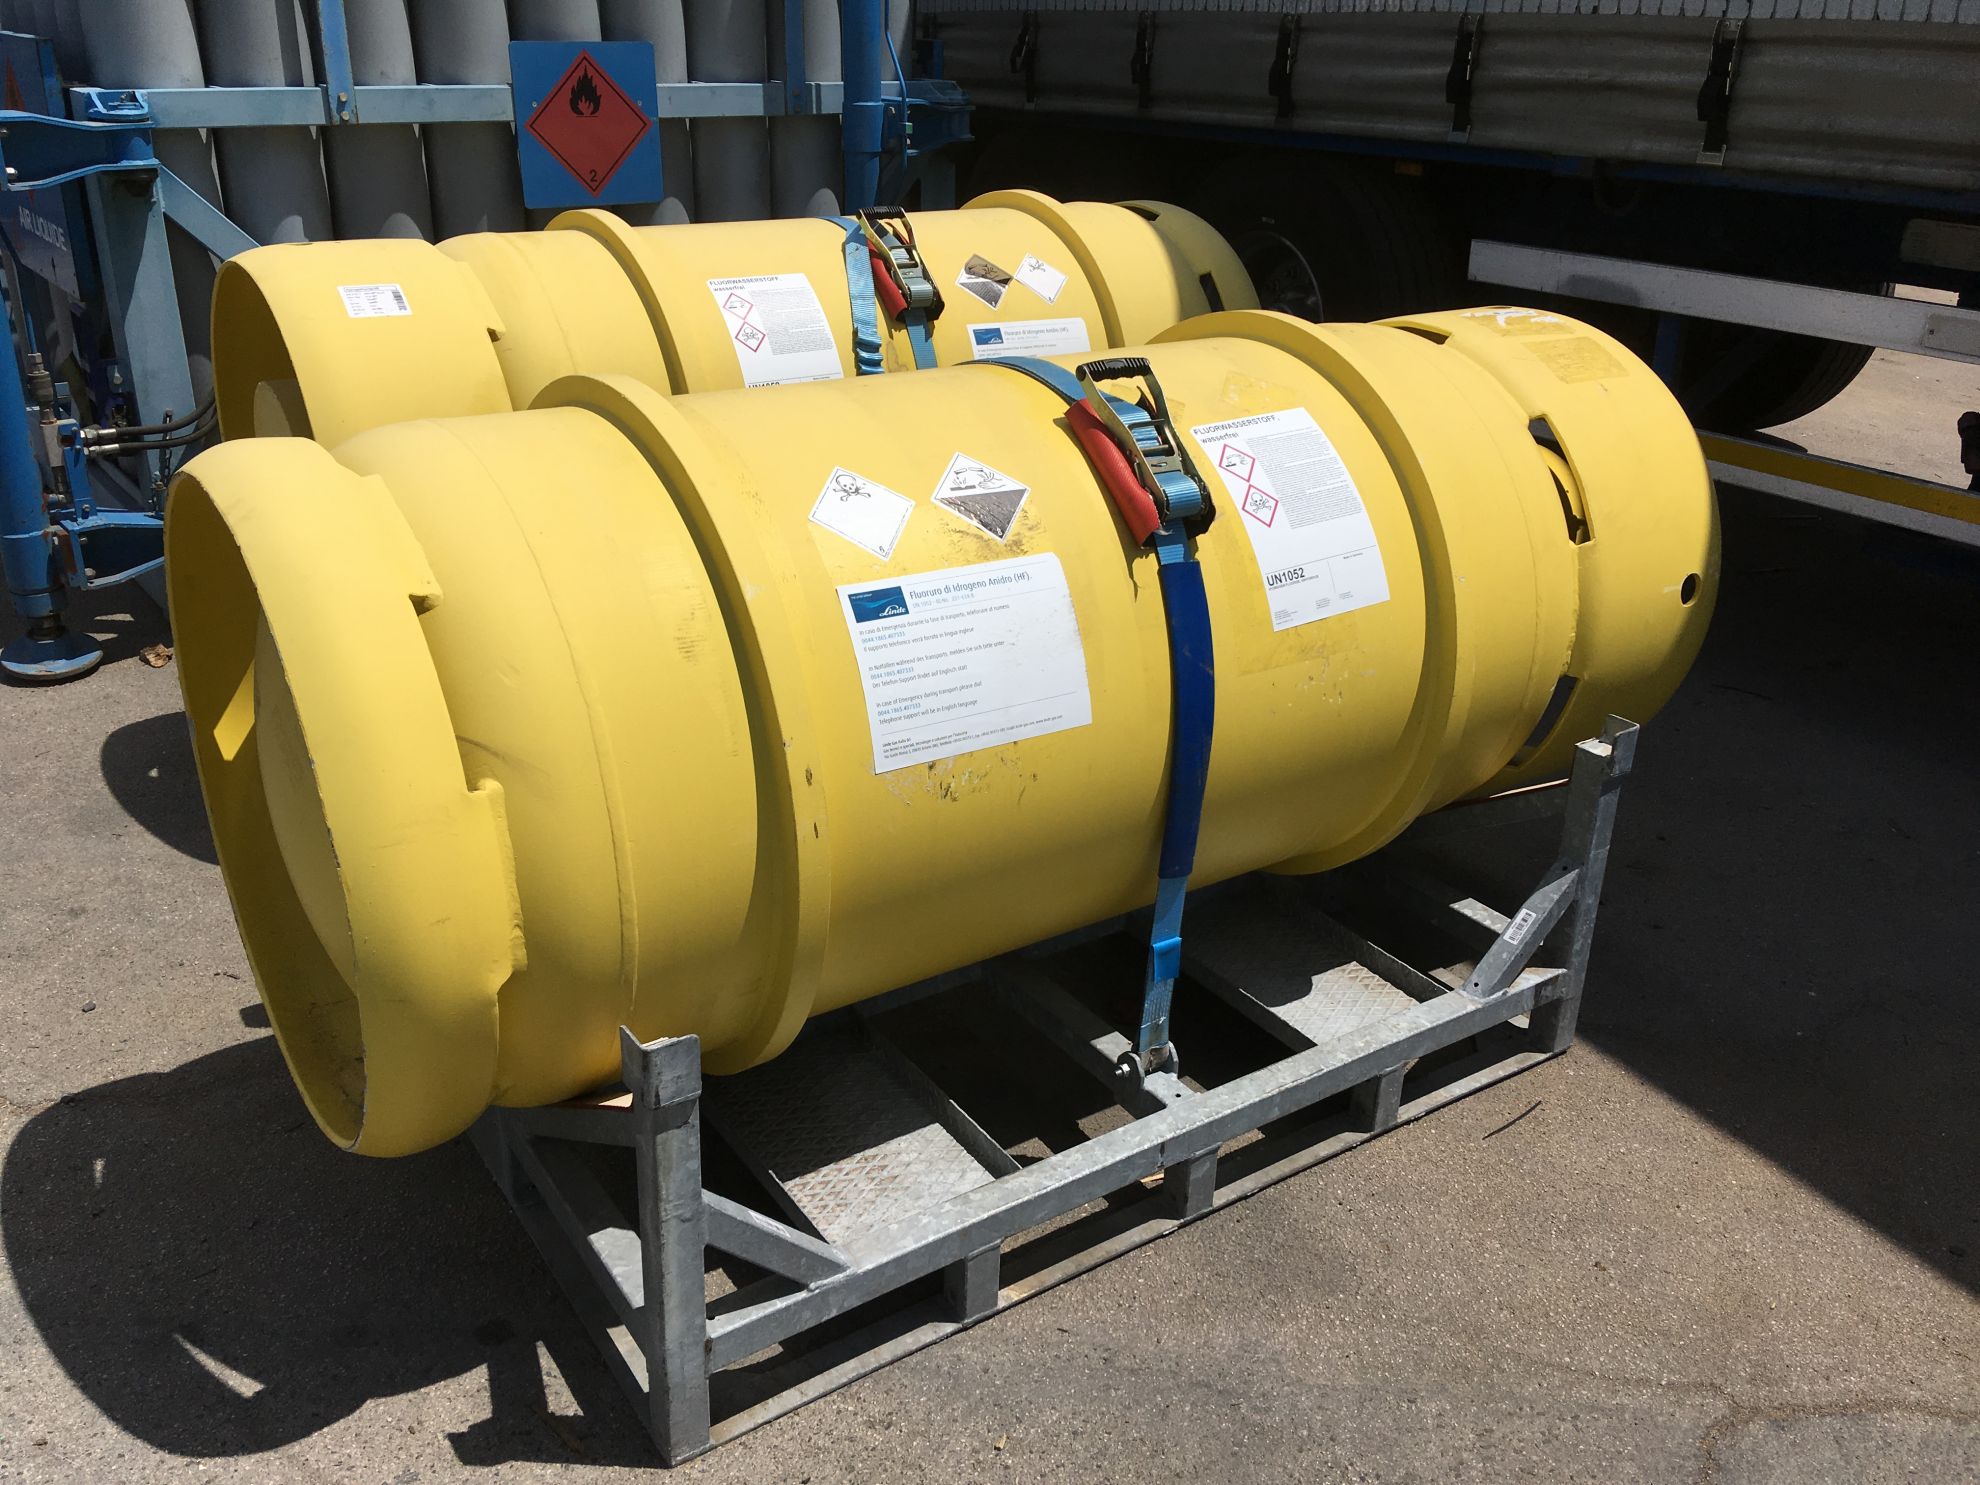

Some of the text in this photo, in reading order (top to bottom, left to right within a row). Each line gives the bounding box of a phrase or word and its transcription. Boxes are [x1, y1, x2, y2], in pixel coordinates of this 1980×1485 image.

[590, 169, 597, 182] 2
[19, 206, 67, 251] AIR LIQUIDE
[1201, 431, 1239, 444] wasserfrei
[1266, 567, 1305, 587] UN1052
[909, 586, 942, 599] Fluoruro
[944, 584, 951, 593] di
[953, 578, 986, 593] Idrogeno
[988, 574, 1012, 586] Anidro
[879, 605, 906, 617] Linde
